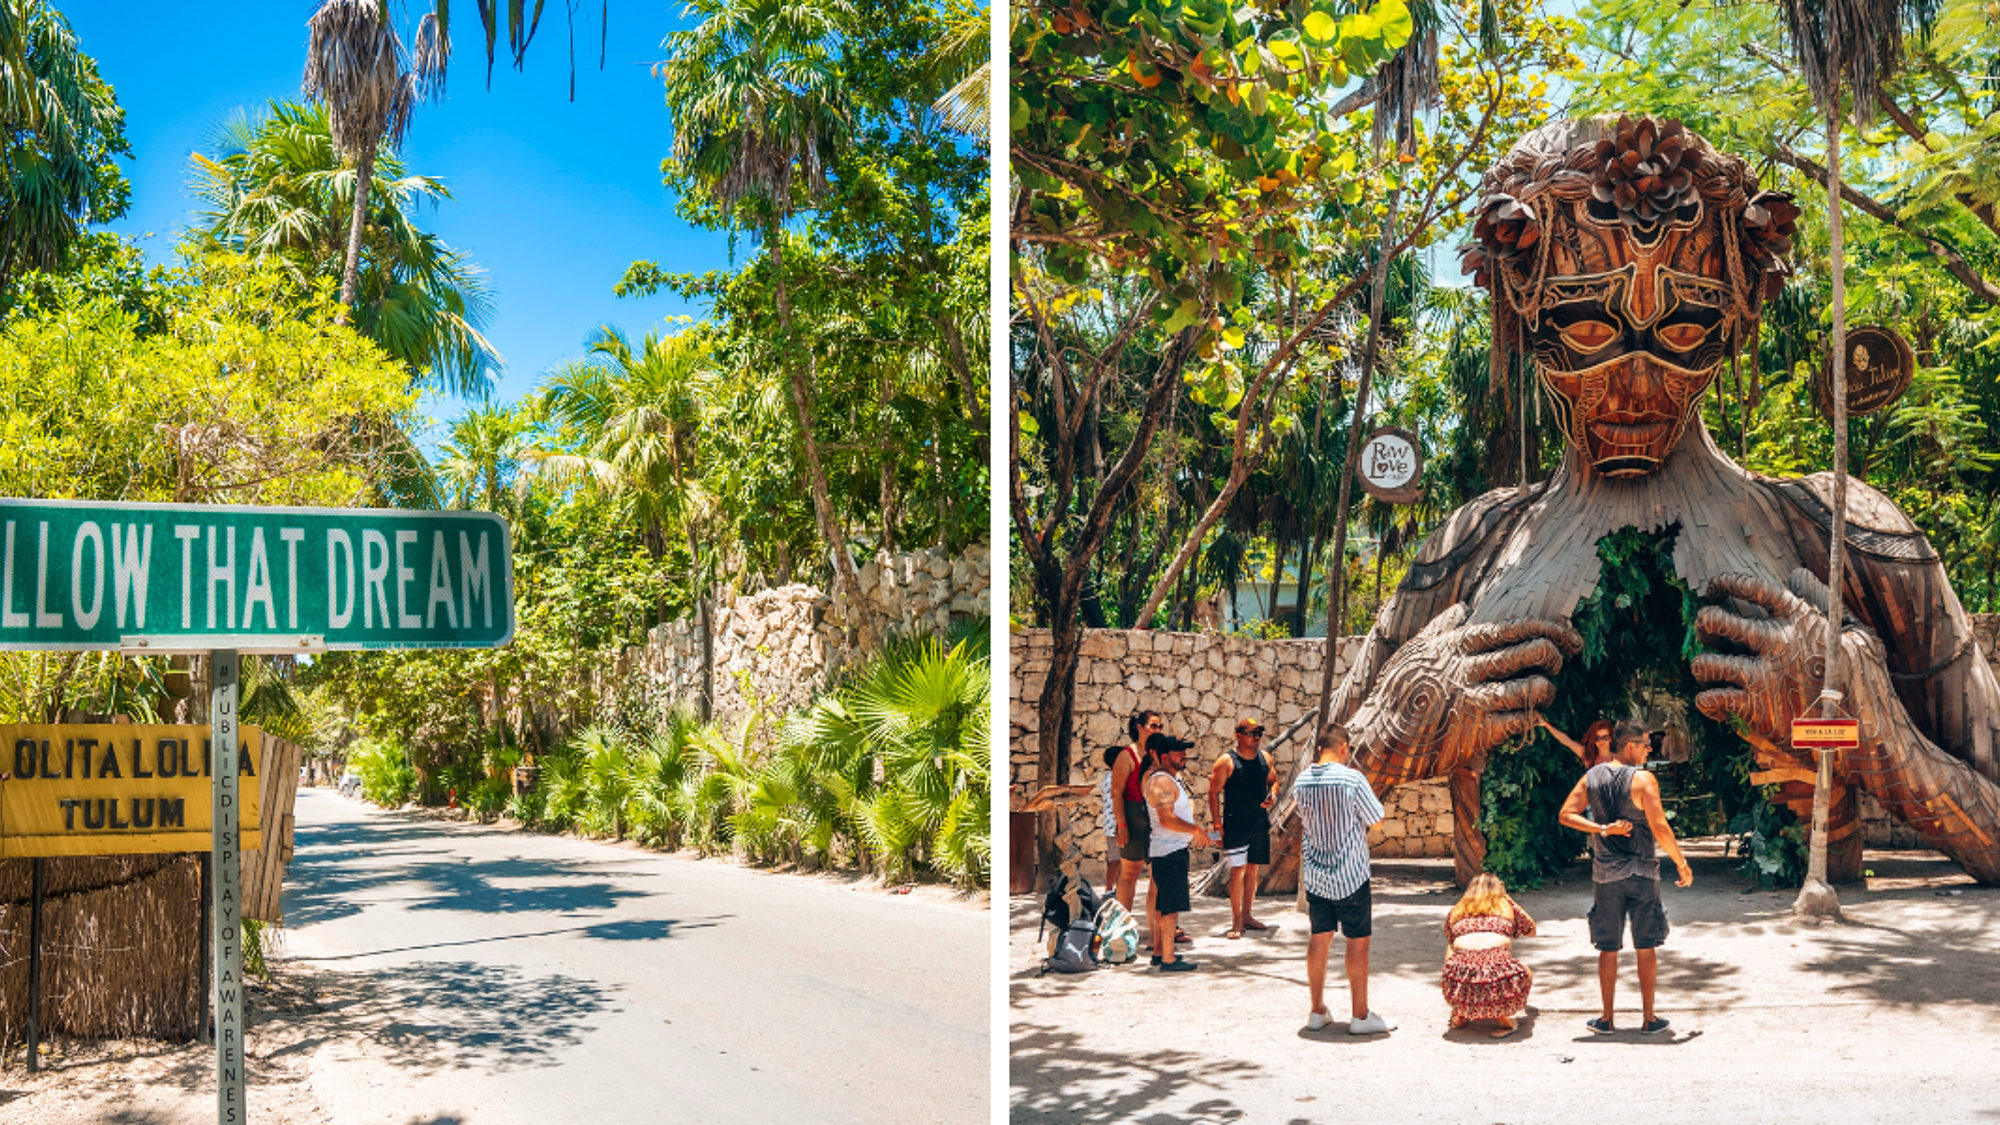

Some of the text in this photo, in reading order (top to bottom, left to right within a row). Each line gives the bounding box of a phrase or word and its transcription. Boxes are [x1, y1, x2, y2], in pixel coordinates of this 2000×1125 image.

[2, 520, 494, 631] LLOW THAT DREAM
[13, 738, 256, 780] OLITA LOLIA
[60, 797, 185, 830] TULUM
